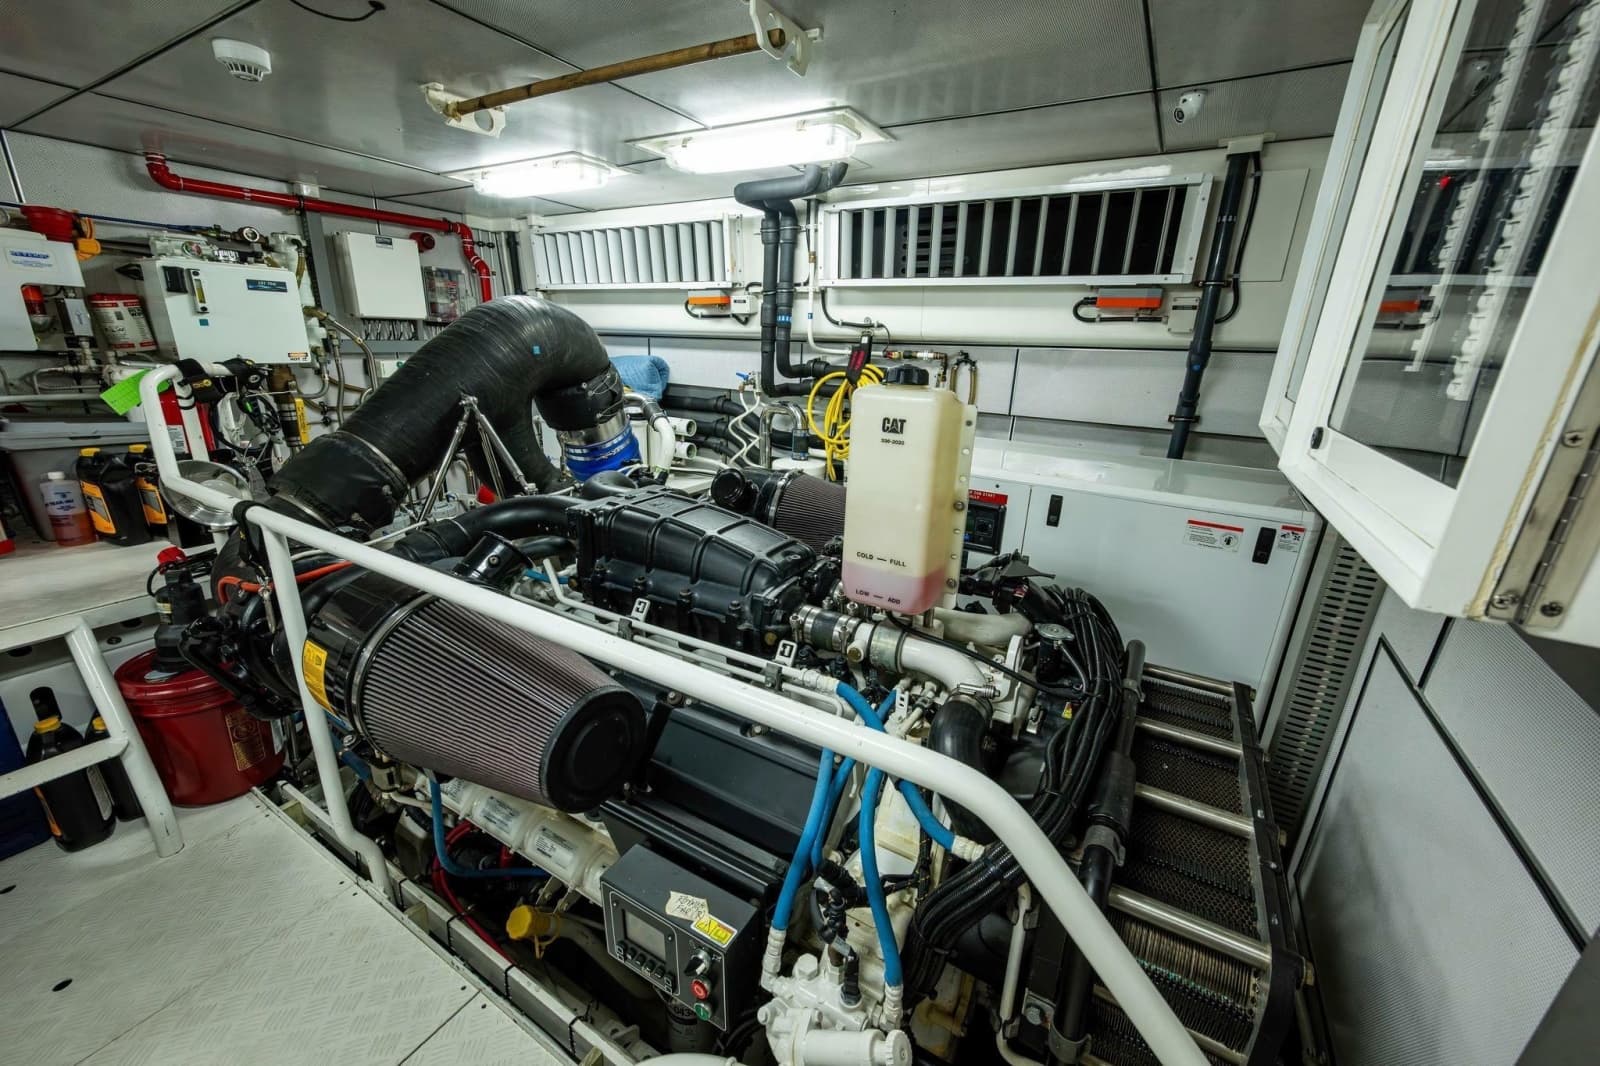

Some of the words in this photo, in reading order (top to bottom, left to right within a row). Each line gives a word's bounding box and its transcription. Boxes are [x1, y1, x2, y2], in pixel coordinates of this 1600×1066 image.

[882, 417, 907, 434] CAT
[856, 551, 874, 560] COLD
[890, 558, 907, 567] FULL
[856, 589, 870, 597] LOW
[888, 597, 901, 605] ADD
